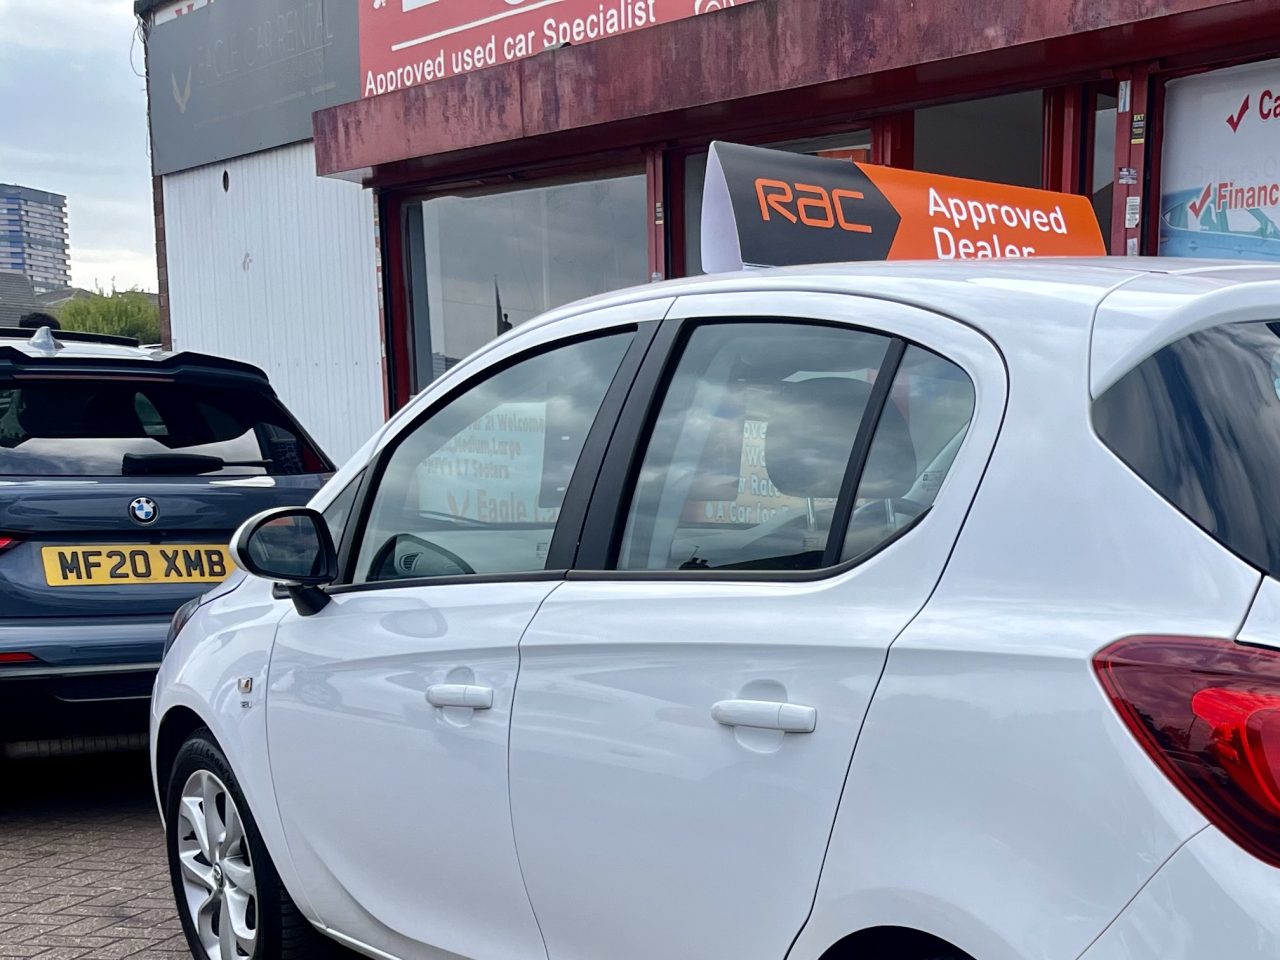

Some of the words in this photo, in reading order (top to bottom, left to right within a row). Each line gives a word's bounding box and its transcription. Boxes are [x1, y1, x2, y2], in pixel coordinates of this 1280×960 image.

[365, 49, 445, 97] Approved
[452, 34, 496, 74] used
[503, 30, 536, 60] car
[543, 0, 656, 47] Specialist
[754, 178, 873, 234] RAC
[928, 187, 1068, 235] Approved
[933, 226, 1036, 260] Dealer
[58, 549, 152, 580] MF20
[159, 549, 226, 577] XMB
